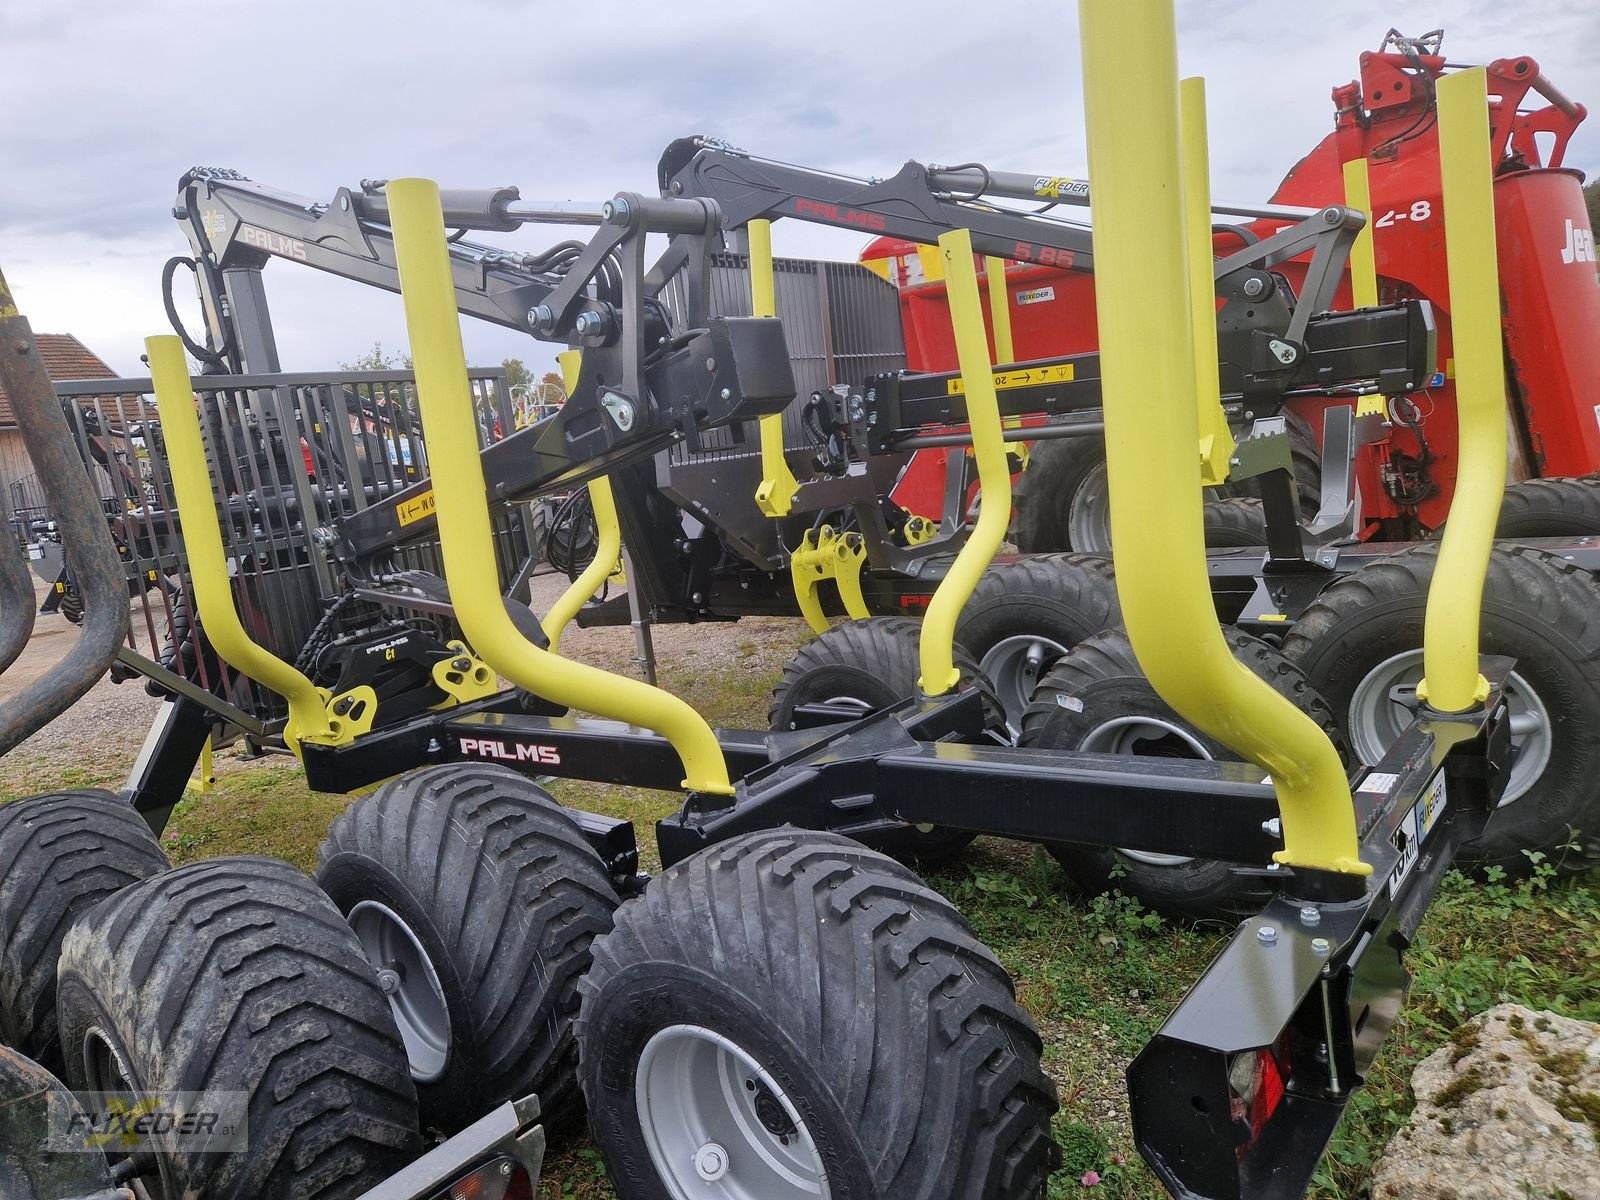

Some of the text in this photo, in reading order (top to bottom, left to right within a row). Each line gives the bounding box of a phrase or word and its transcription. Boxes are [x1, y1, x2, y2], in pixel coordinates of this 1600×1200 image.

[1034, 178, 1088, 193] FLIXEDER
[795, 197, 885, 231] PALMS
[243, 226, 307, 260] PALMS
[1014, 240, 1075, 268] 5.85
[1019, 290, 1049, 303] FLIXEDER
[366, 636, 409, 654] PALMS
[459, 737, 561, 765] PALMS
